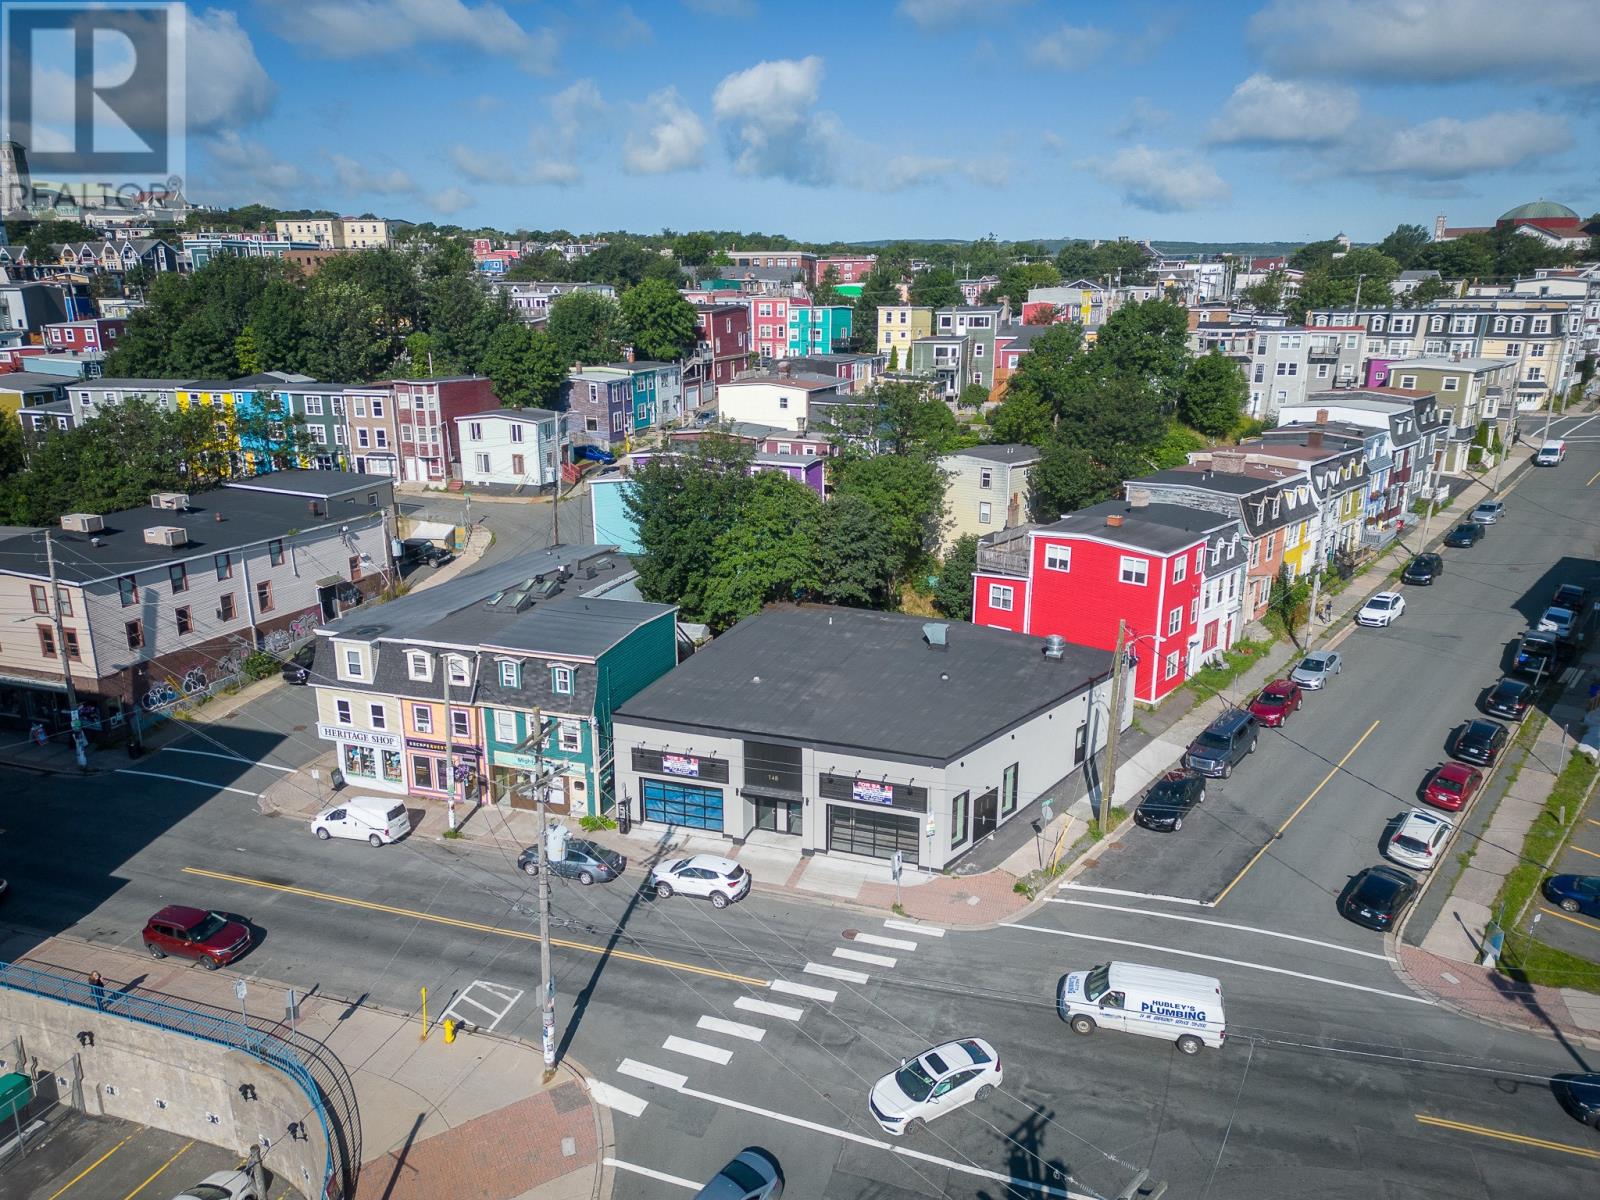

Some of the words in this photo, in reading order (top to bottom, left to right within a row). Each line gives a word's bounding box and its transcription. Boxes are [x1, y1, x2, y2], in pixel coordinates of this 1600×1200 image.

[324, 728, 369, 742] HERITAGE
[371, 735, 395, 745] SHOP
[1141, 1001, 1206, 1021] PLUMBING
[1152, 1000, 1196, 1012] HUBLEY'S
